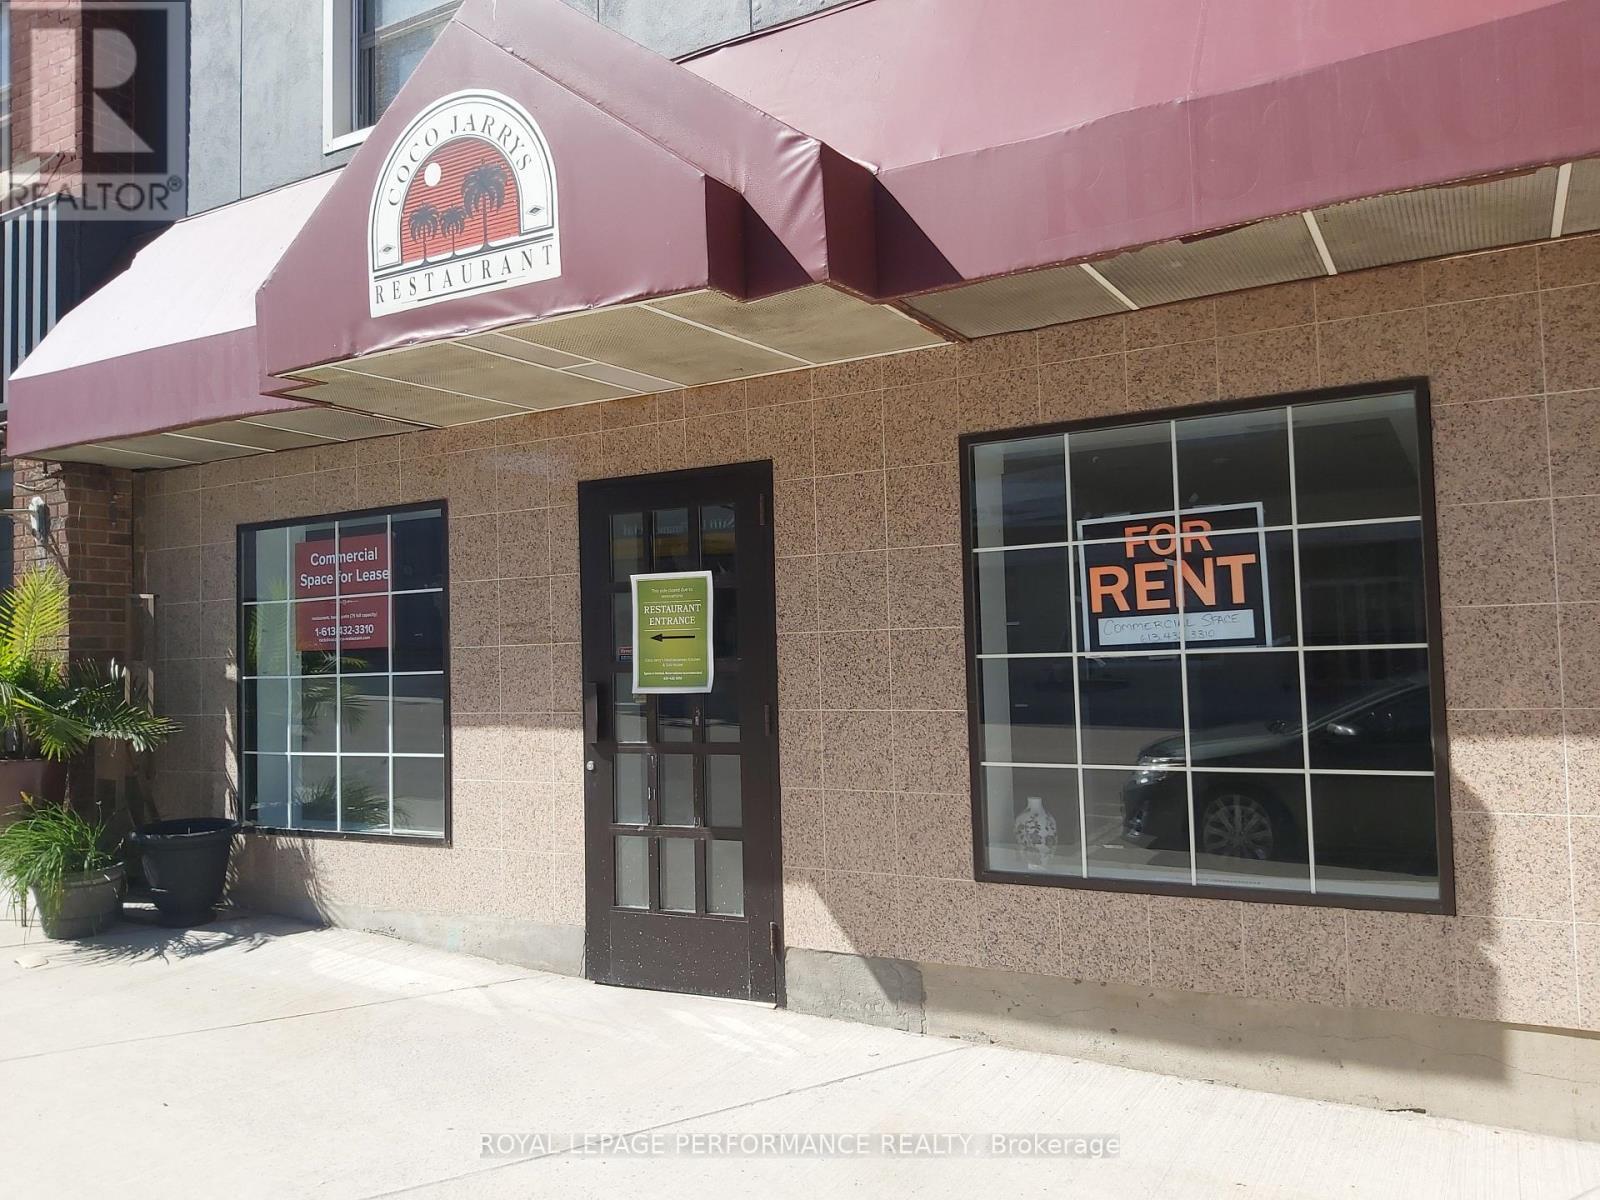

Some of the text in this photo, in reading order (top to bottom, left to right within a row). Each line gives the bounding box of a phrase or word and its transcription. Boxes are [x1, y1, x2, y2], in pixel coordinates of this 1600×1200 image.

[387, 113, 532, 206] COCO JARRYS
[375, 244, 553, 304] RESTAURANT
[1124, 520, 1213, 558] FOR
[310, 547, 378, 566] Commercial
[300, 573, 334, 589] Space
[356, 568, 390, 582] Lease
[1089, 554, 1256, 613] RENT
[644, 604, 701, 614] RESTAURANT
[649, 616, 696, 626] ENTRANCE
[1200, 613, 1240, 627] SPACE
[314, 624, 374, 637] 1-613432-3310
